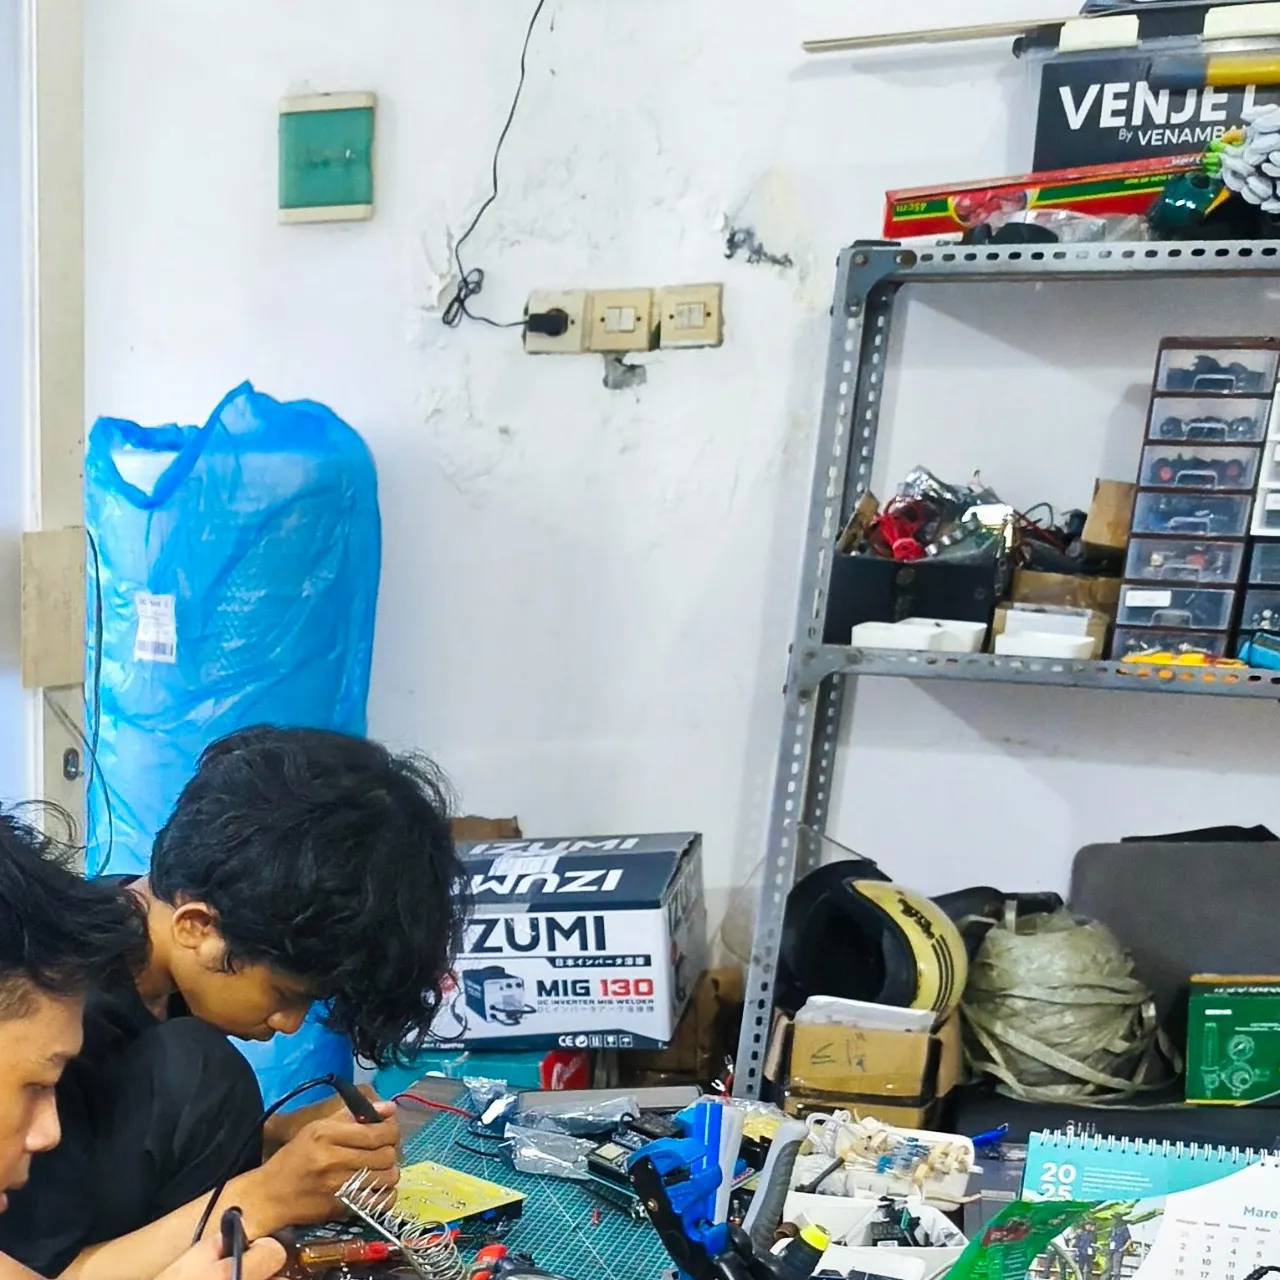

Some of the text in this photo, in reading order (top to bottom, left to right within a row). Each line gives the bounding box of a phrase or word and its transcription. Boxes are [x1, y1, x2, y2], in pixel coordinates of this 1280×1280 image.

[1058, 80, 1229, 131] VENJE
[1118, 128, 1134, 143] By
[469, 838, 640, 856] IZUMI
[536, 978, 654, 998] MIG 130
[1040, 1162, 1077, 1185] 20
[1201, 1257, 1212, 1267] 10
[1200, 1270, 1210, 1279] 17
